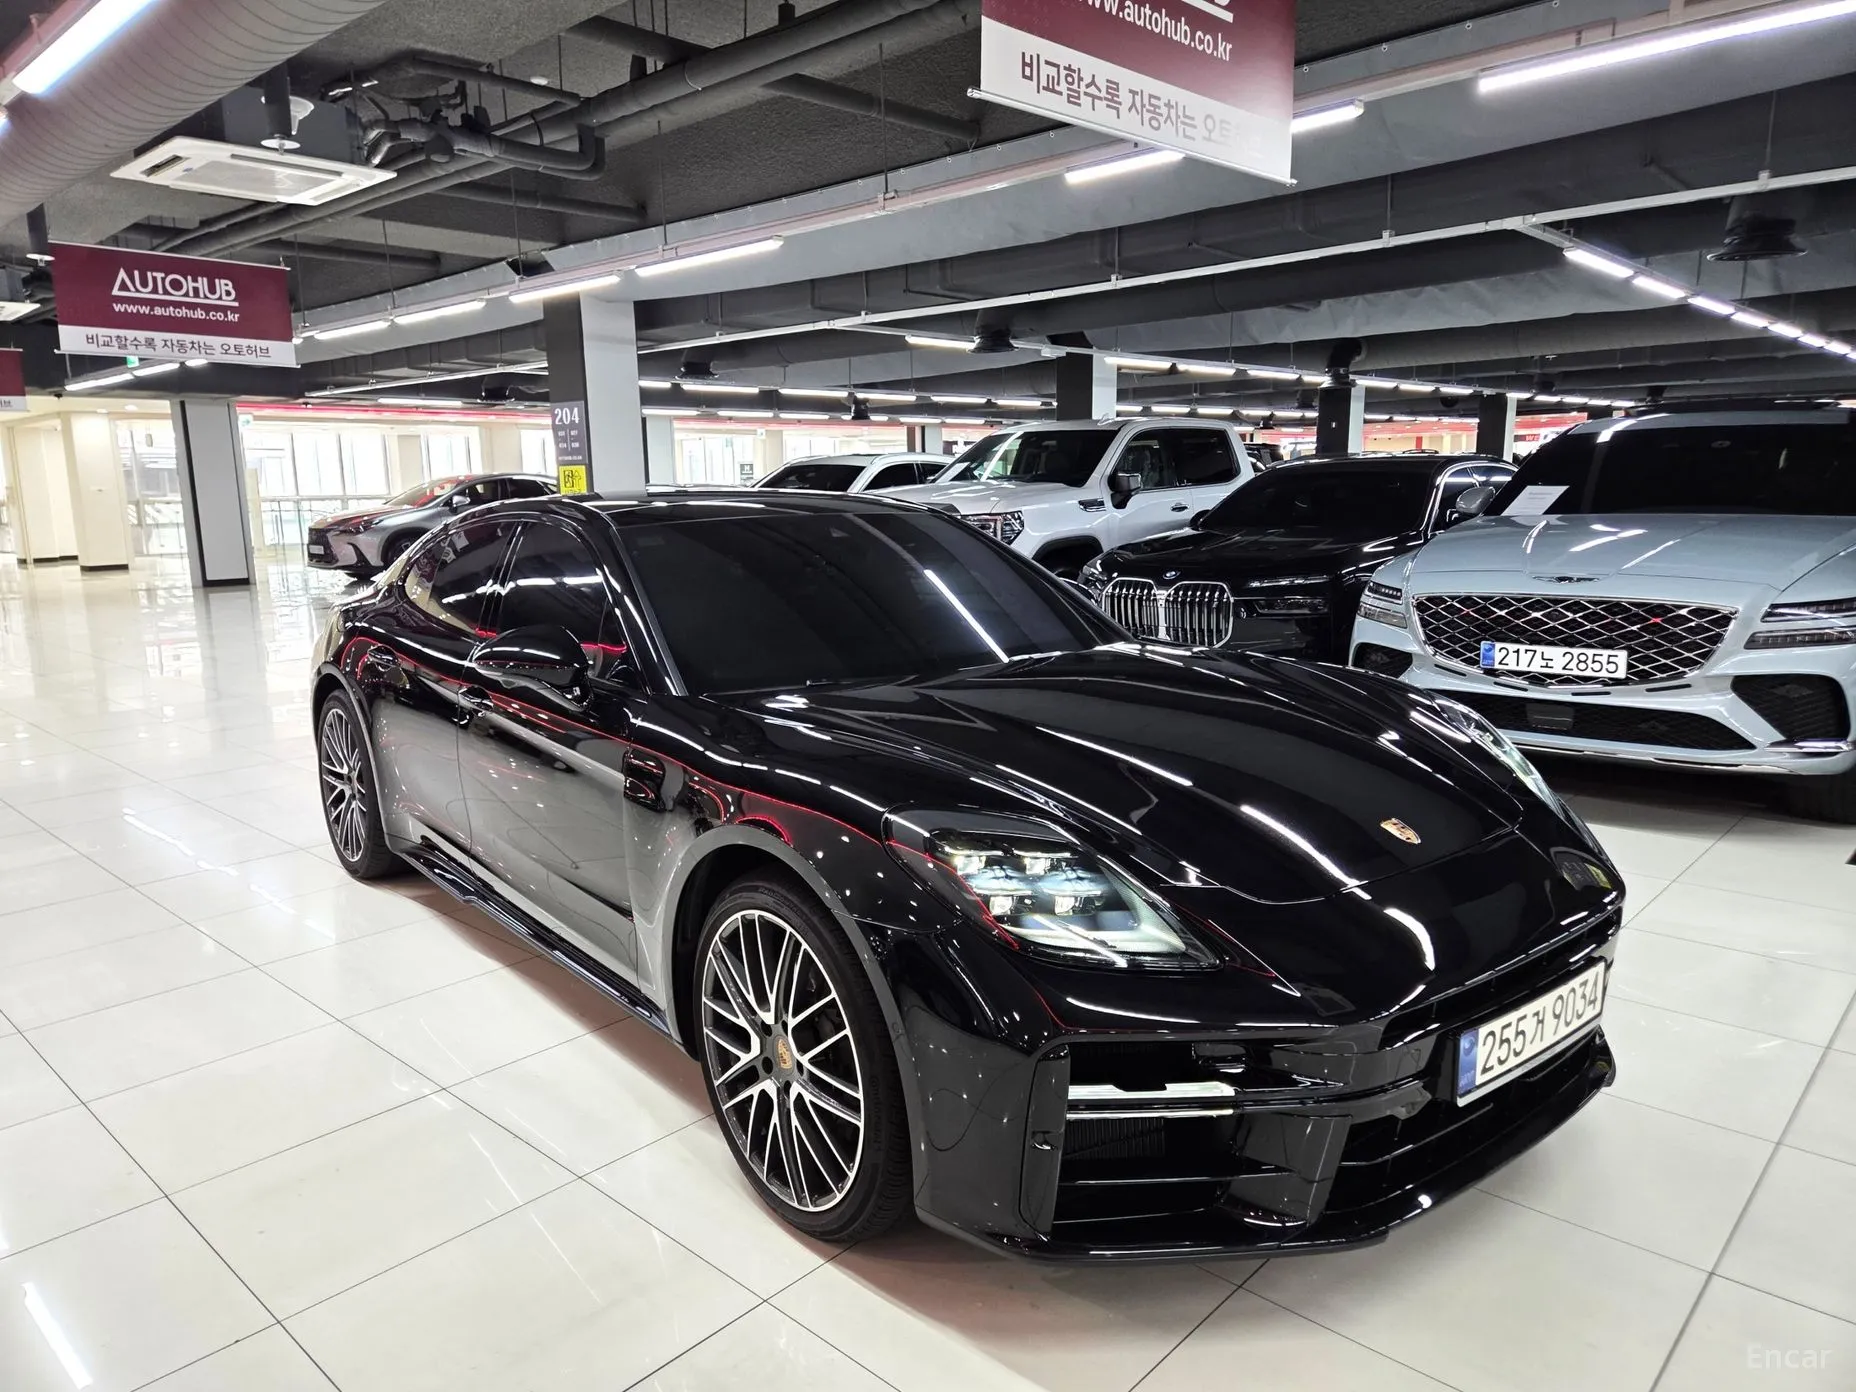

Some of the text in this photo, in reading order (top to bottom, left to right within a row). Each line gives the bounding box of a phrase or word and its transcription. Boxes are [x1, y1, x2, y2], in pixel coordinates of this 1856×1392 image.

[1079, 0, 1233, 61] w.autohub.co.kr
[1021, 52, 1122, 119] 비교할수록
[1128, 88, 1197, 141] 자동차는
[112, 267, 237, 302] AUTOHUB
[112, 302, 239, 322] www.autohub.co.kr
[86, 333, 272, 358] 비교할수록 자동차는 오토허브
[554, 407, 580, 425] 204
[1498, 647, 1619, 674] 217노 2855
[1480, 971, 1599, 1075] 255거 9034
